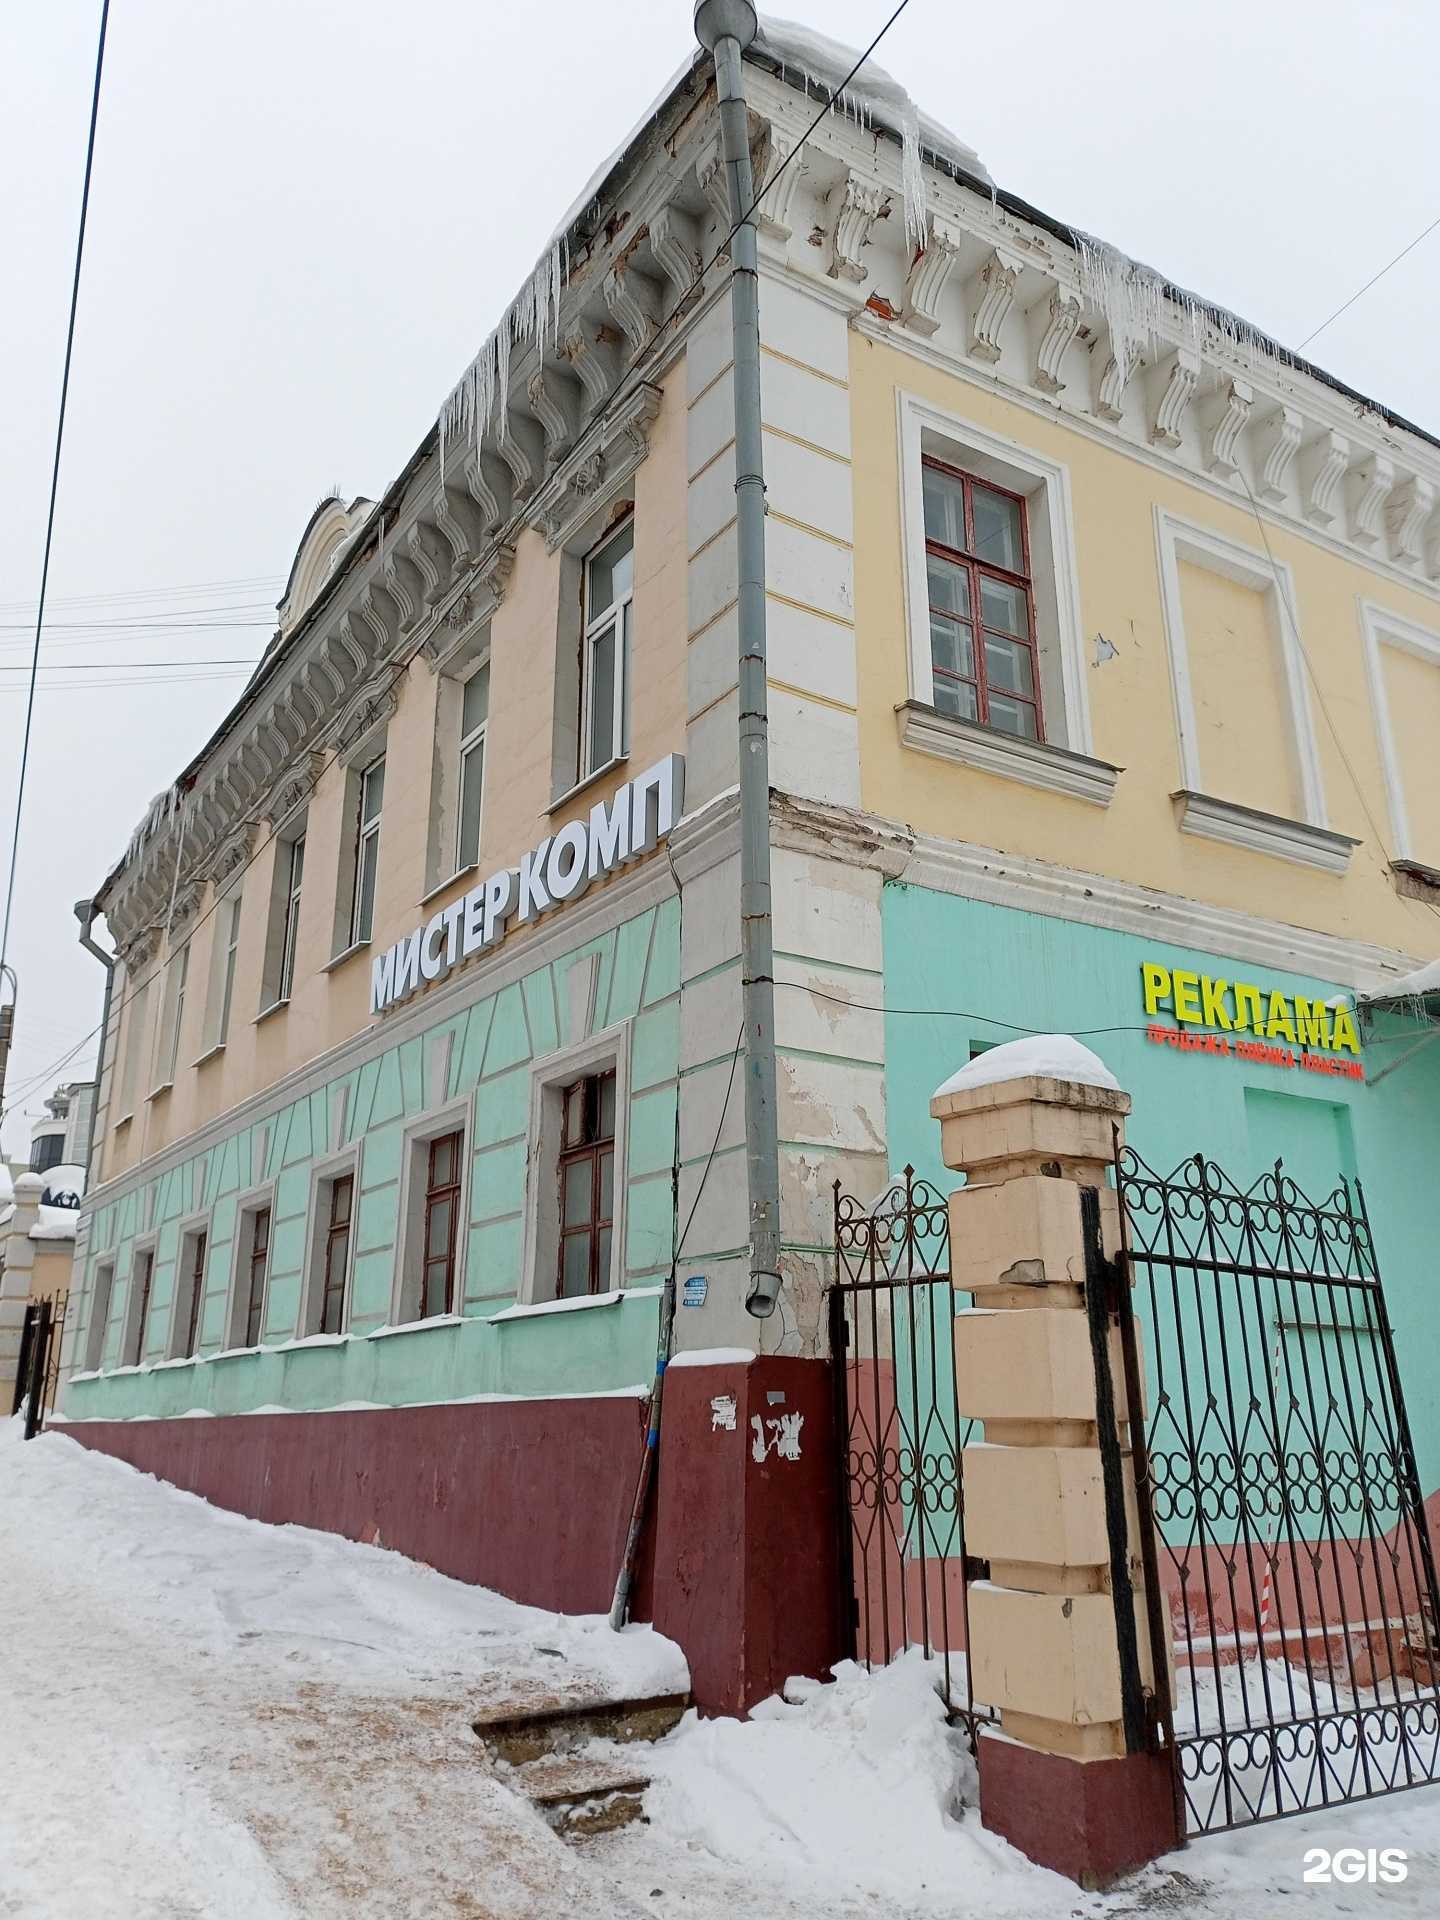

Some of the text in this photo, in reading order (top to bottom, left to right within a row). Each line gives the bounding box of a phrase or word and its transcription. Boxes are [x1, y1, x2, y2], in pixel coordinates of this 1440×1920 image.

[370, 752, 686, 1016] МИСТЕР КОМП
[1141, 961, 1361, 1055] РЕКЛАМА
[1147, 1023, 1231, 1056] ПРОДАЖА
